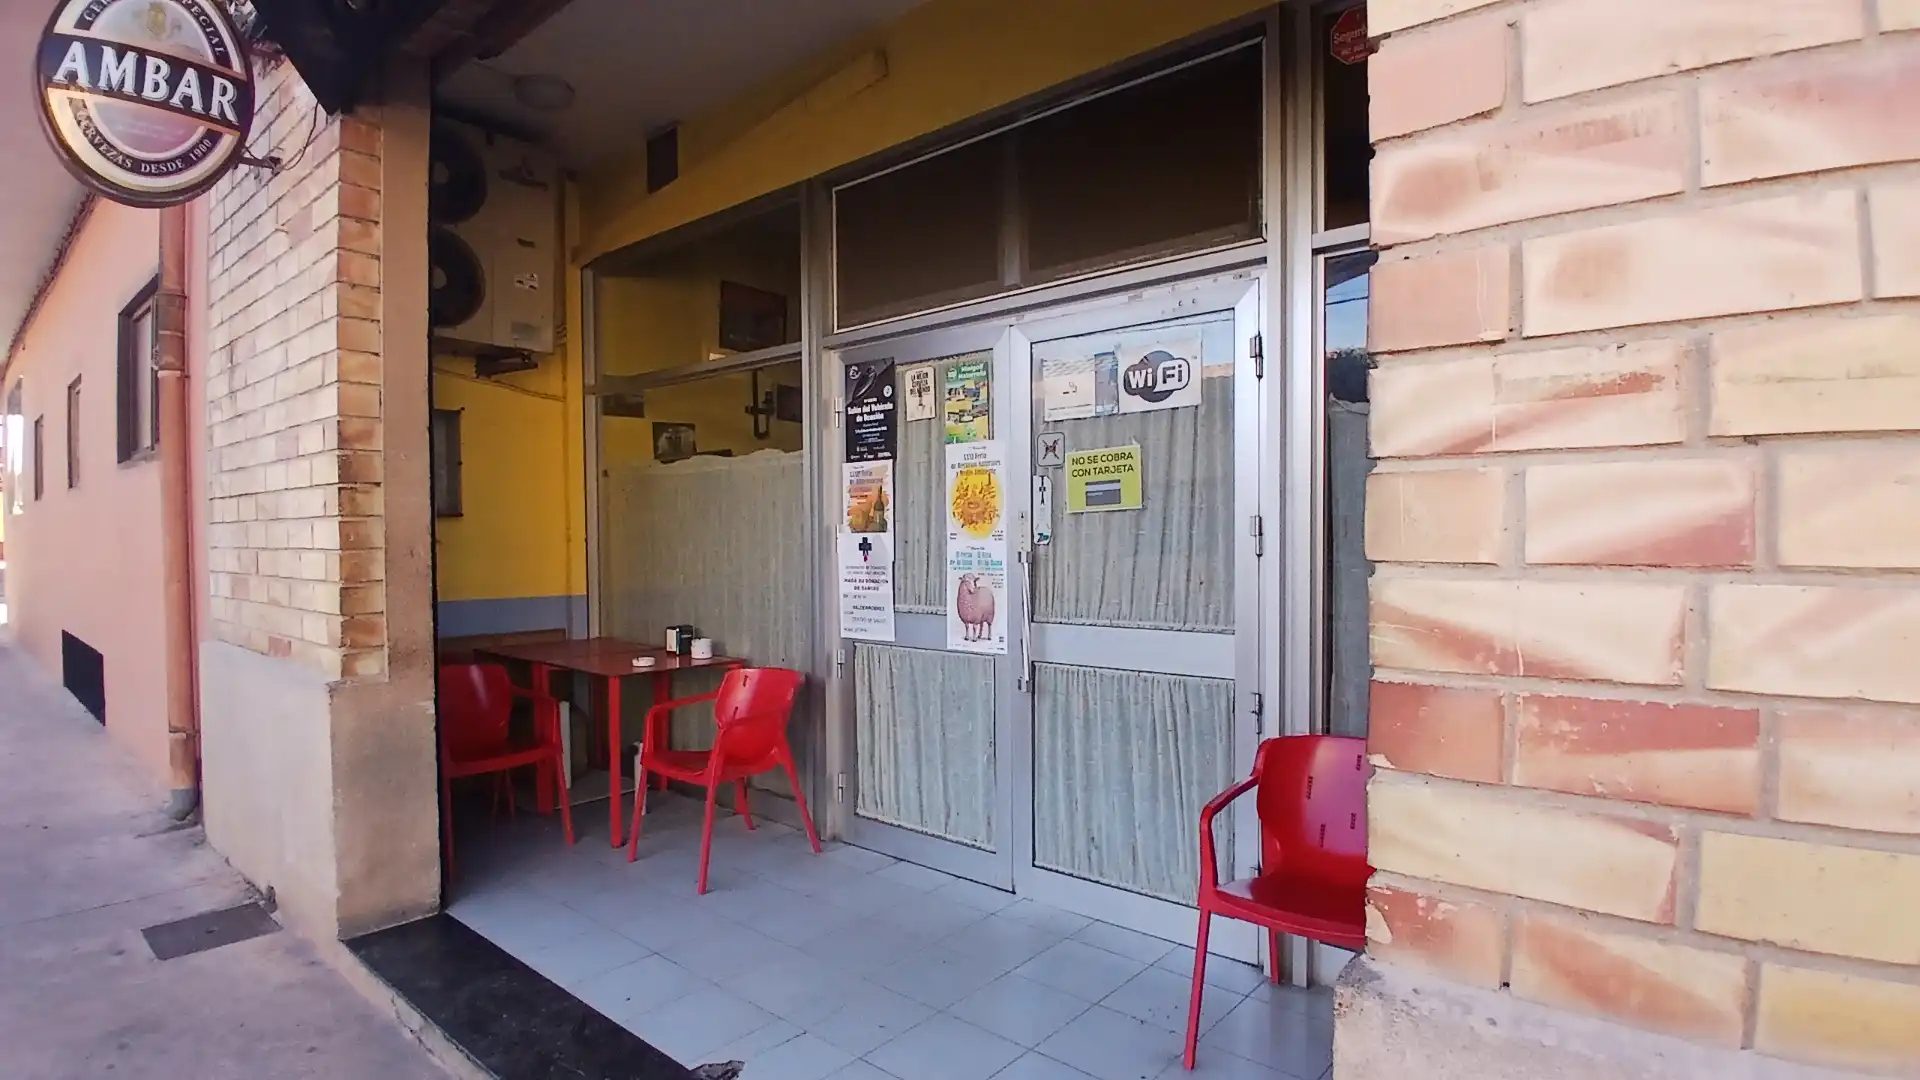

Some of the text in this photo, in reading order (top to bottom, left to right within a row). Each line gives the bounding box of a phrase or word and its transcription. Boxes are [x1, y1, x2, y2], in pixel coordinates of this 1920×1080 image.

[52, 41, 239, 124] AMBAR
[77, 110, 212, 173] CERVEZAS DESDE 1900
[1071, 452, 1134, 466] NO SE COBRA
[1071, 463, 1134, 477] CON TARJETA
